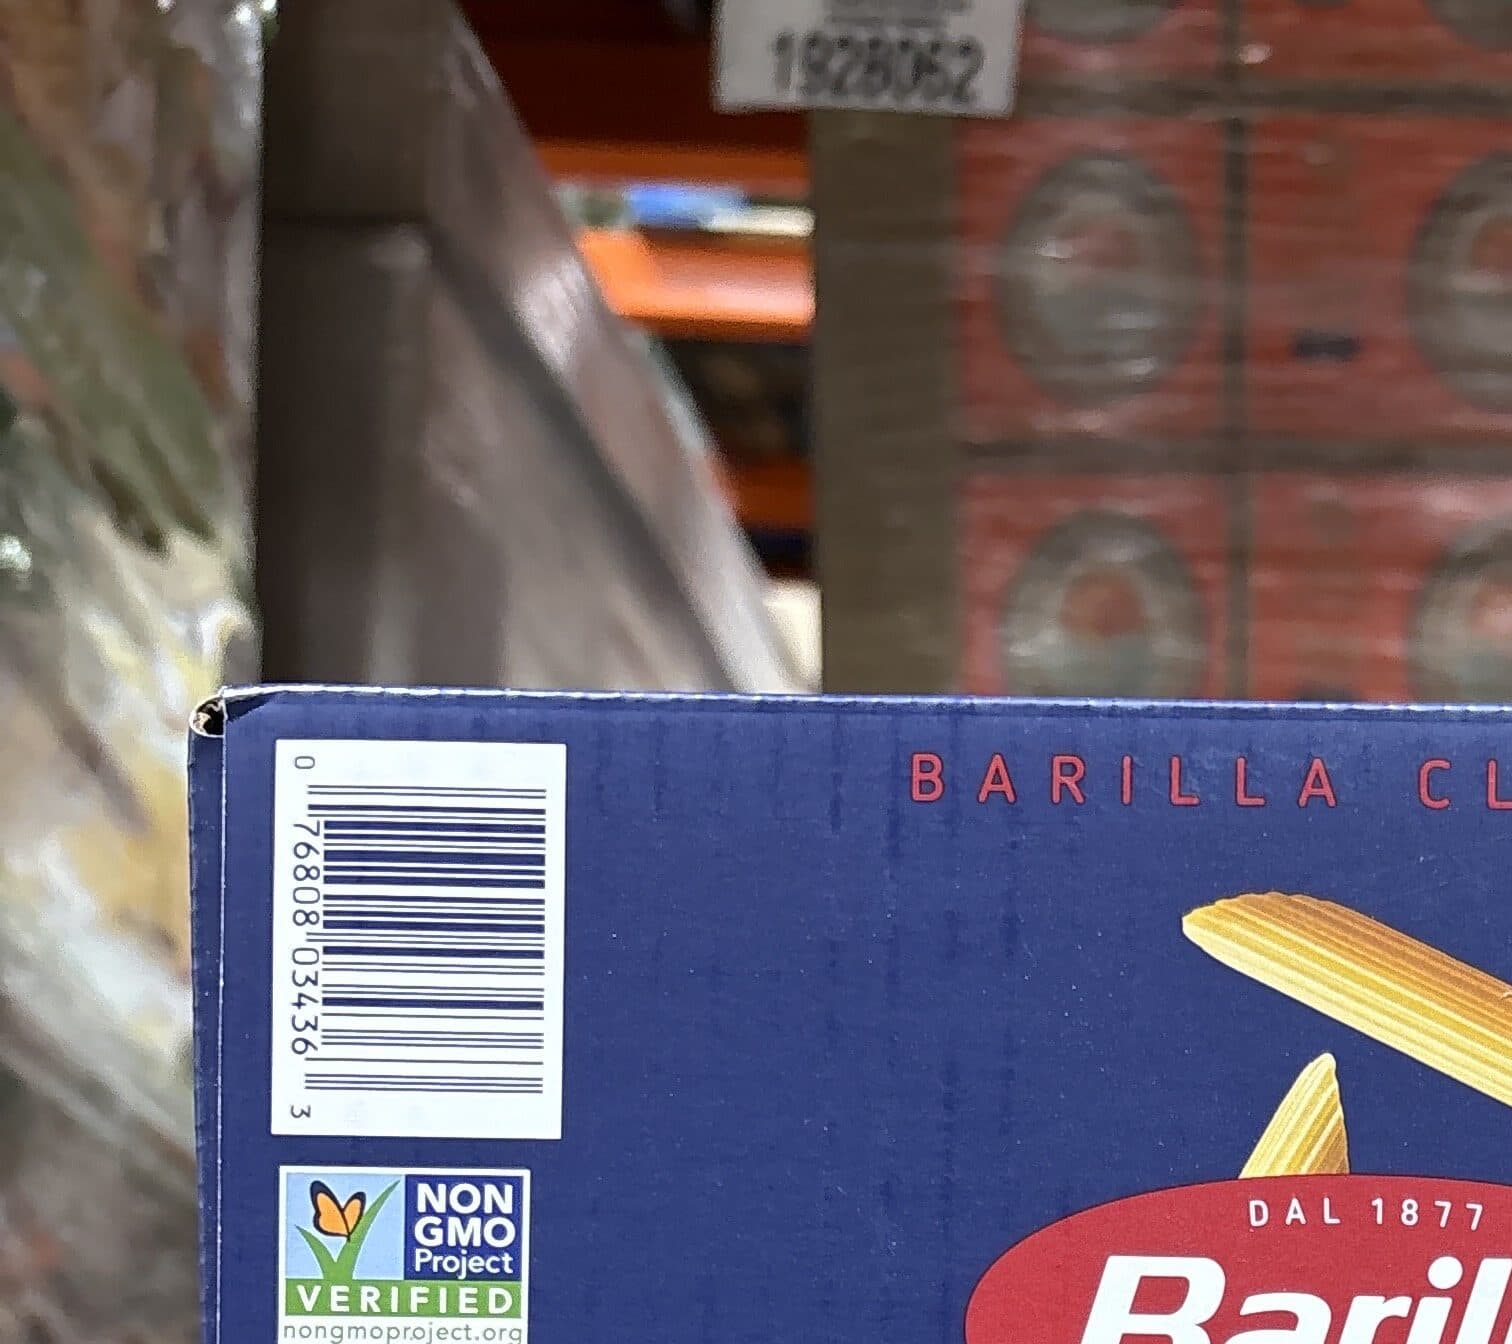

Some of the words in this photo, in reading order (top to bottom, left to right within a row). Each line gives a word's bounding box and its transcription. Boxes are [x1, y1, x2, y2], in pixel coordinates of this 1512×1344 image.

[294, 755, 316, 770] 0
[910, 751, 1336, 806] BARILLA
[292, 820, 321, 927] 76808
[291, 947, 320, 1056] 03436
[290, 1105, 312, 1119] 3
[417, 1183, 513, 1214] NON
[1249, 1197, 1341, 1227] DAL
[1371, 1197, 1483, 1231] 1877
[414, 1216, 516, 1248] GMO
[414, 1248, 514, 1279] Project
[296, 1285, 513, 1314] VERIFIED
